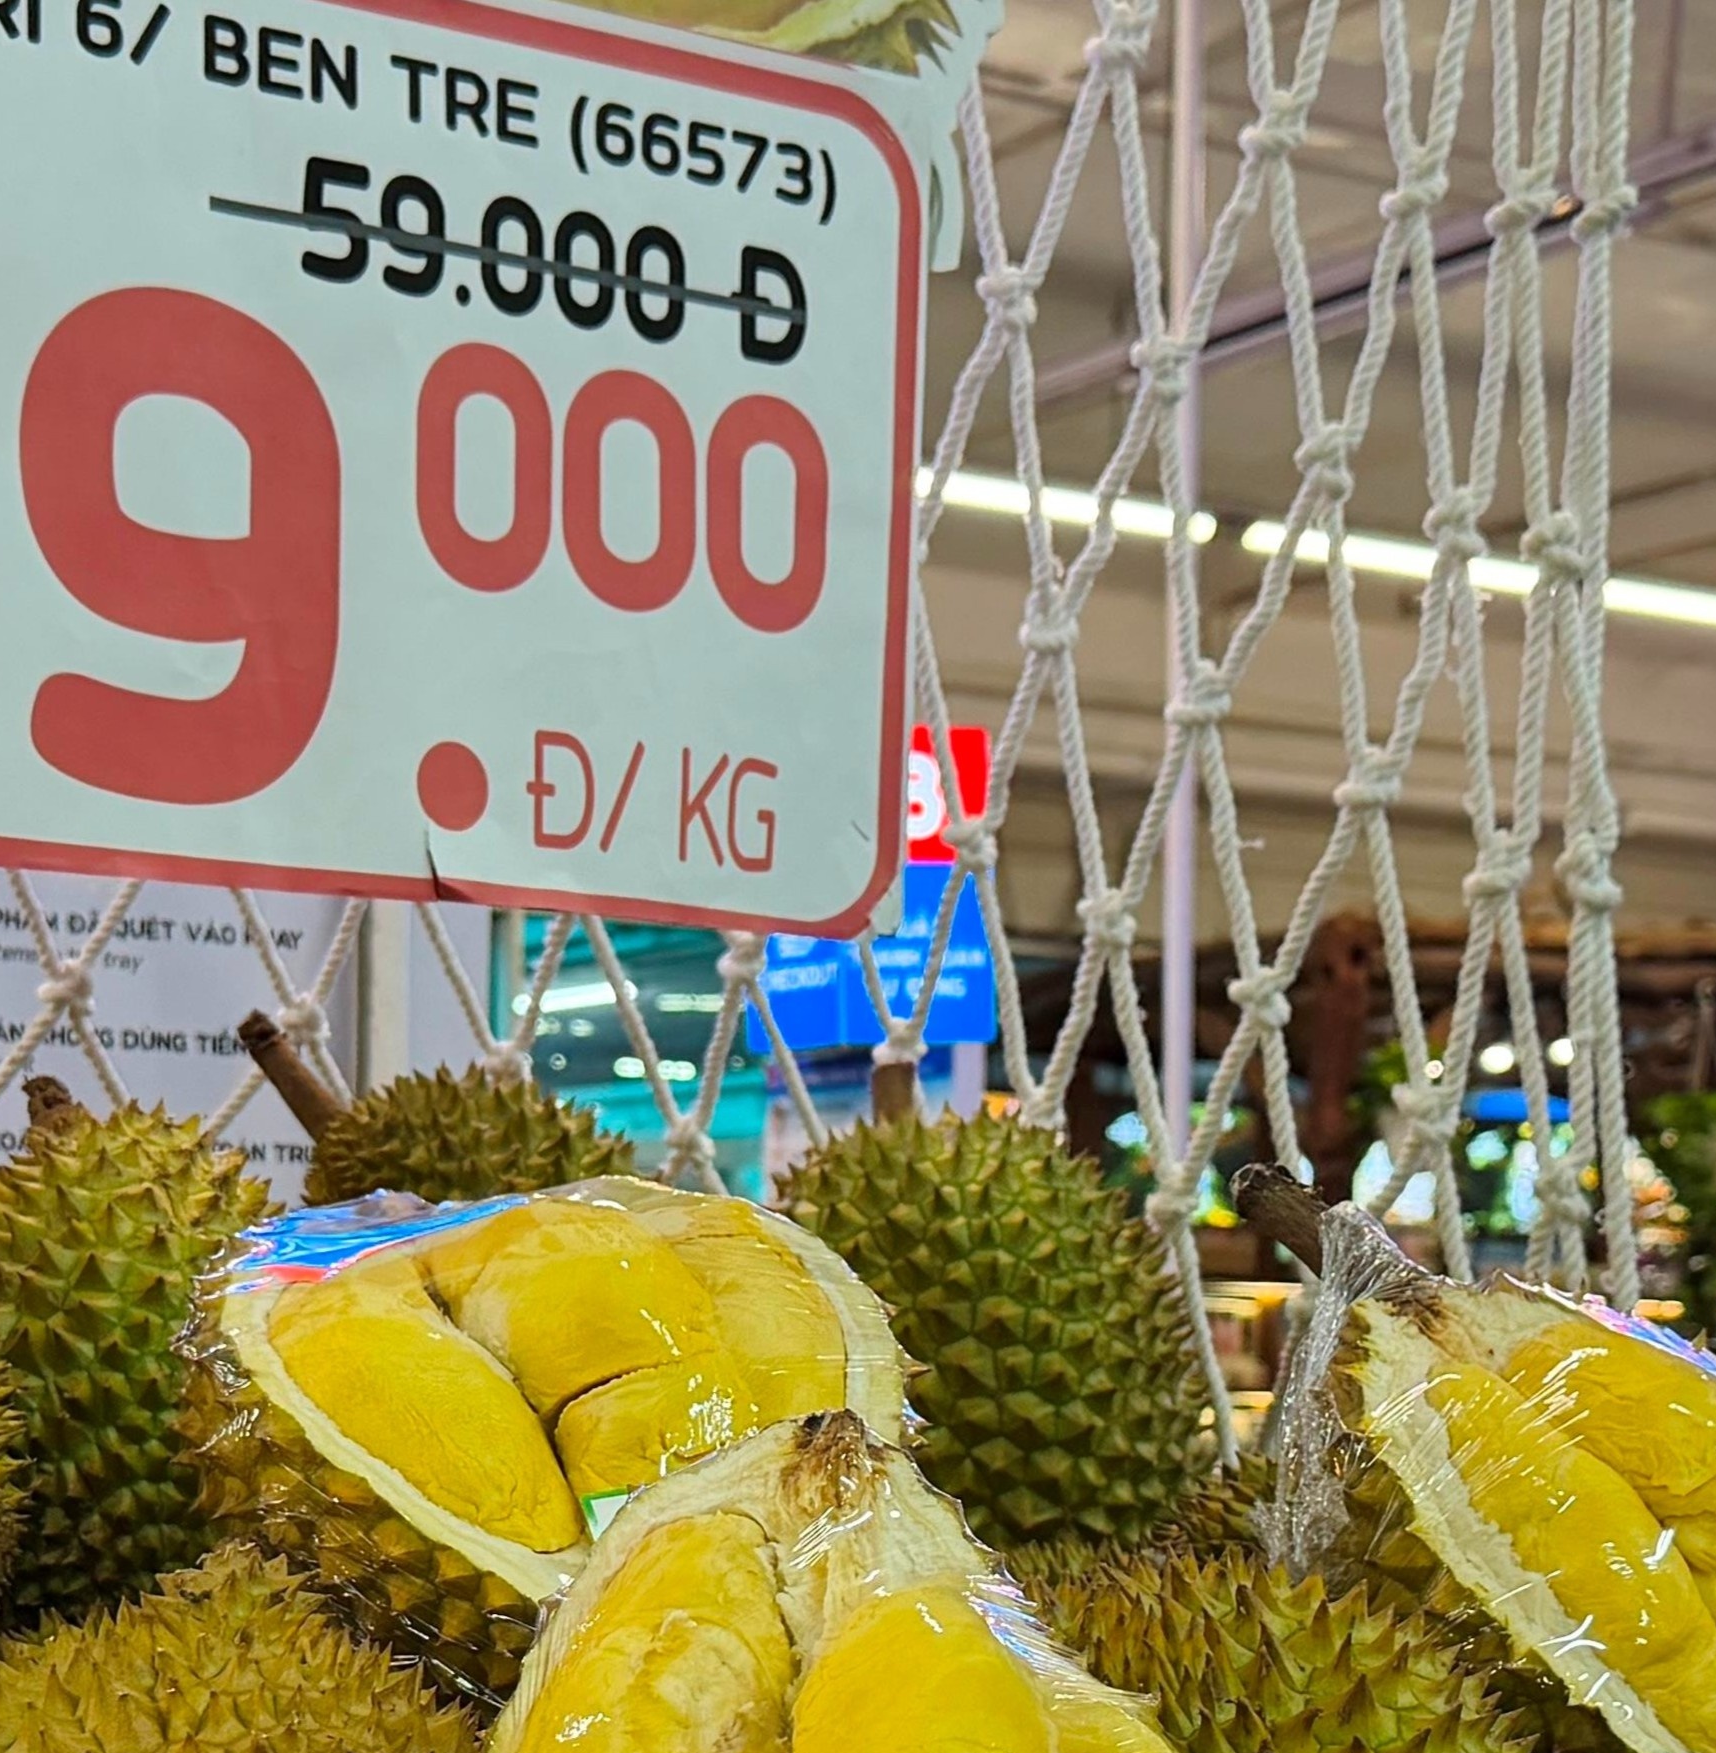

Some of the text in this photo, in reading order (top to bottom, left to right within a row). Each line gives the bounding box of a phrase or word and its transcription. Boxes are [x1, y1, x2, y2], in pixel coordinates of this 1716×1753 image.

[203, 14, 359, 109] BEN
[391, 54, 540, 148] TRE
[570, 95, 837, 225] (66573)
[299, 155, 685, 344] 59.000
[677, 745, 780, 874] KG
